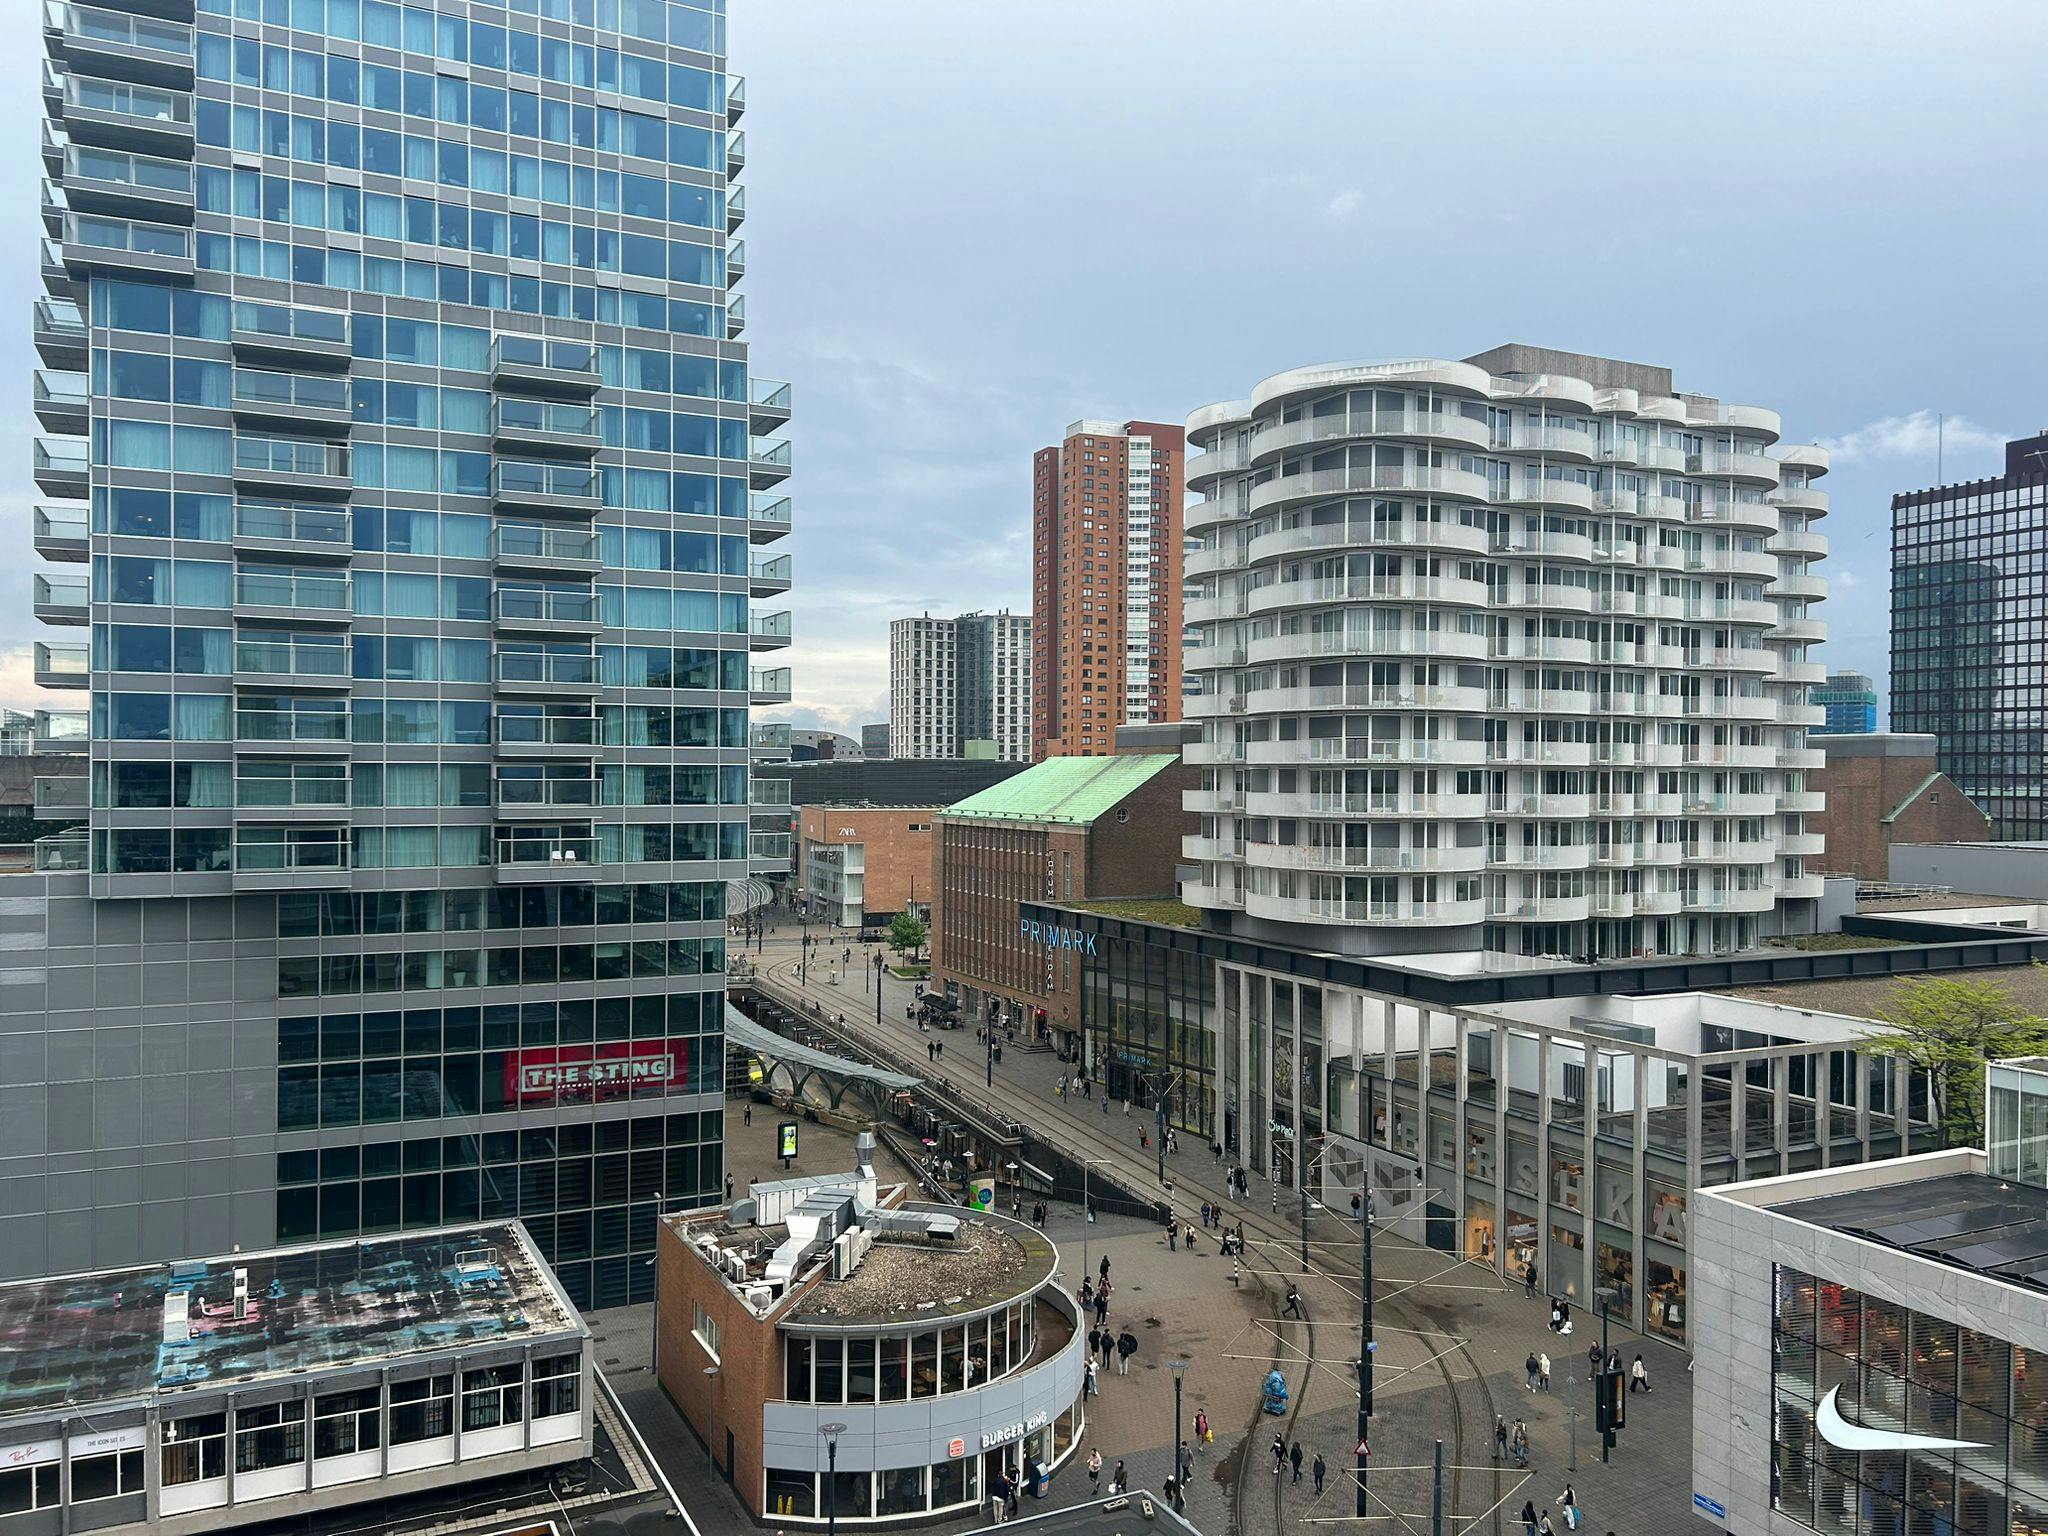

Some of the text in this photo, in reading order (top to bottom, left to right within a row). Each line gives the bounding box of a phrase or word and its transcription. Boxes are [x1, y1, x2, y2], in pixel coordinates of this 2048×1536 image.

[1020, 919, 1097, 957] PRIMARK
[528, 1067, 579, 1086] THE
[588, 1060, 667, 1081] STING
[1118, 1050, 1152, 1066] PRIMARK
[1405, 1122, 1687, 1243] BERSHKA
[982, 1411, 1048, 1448] BURGER KING
